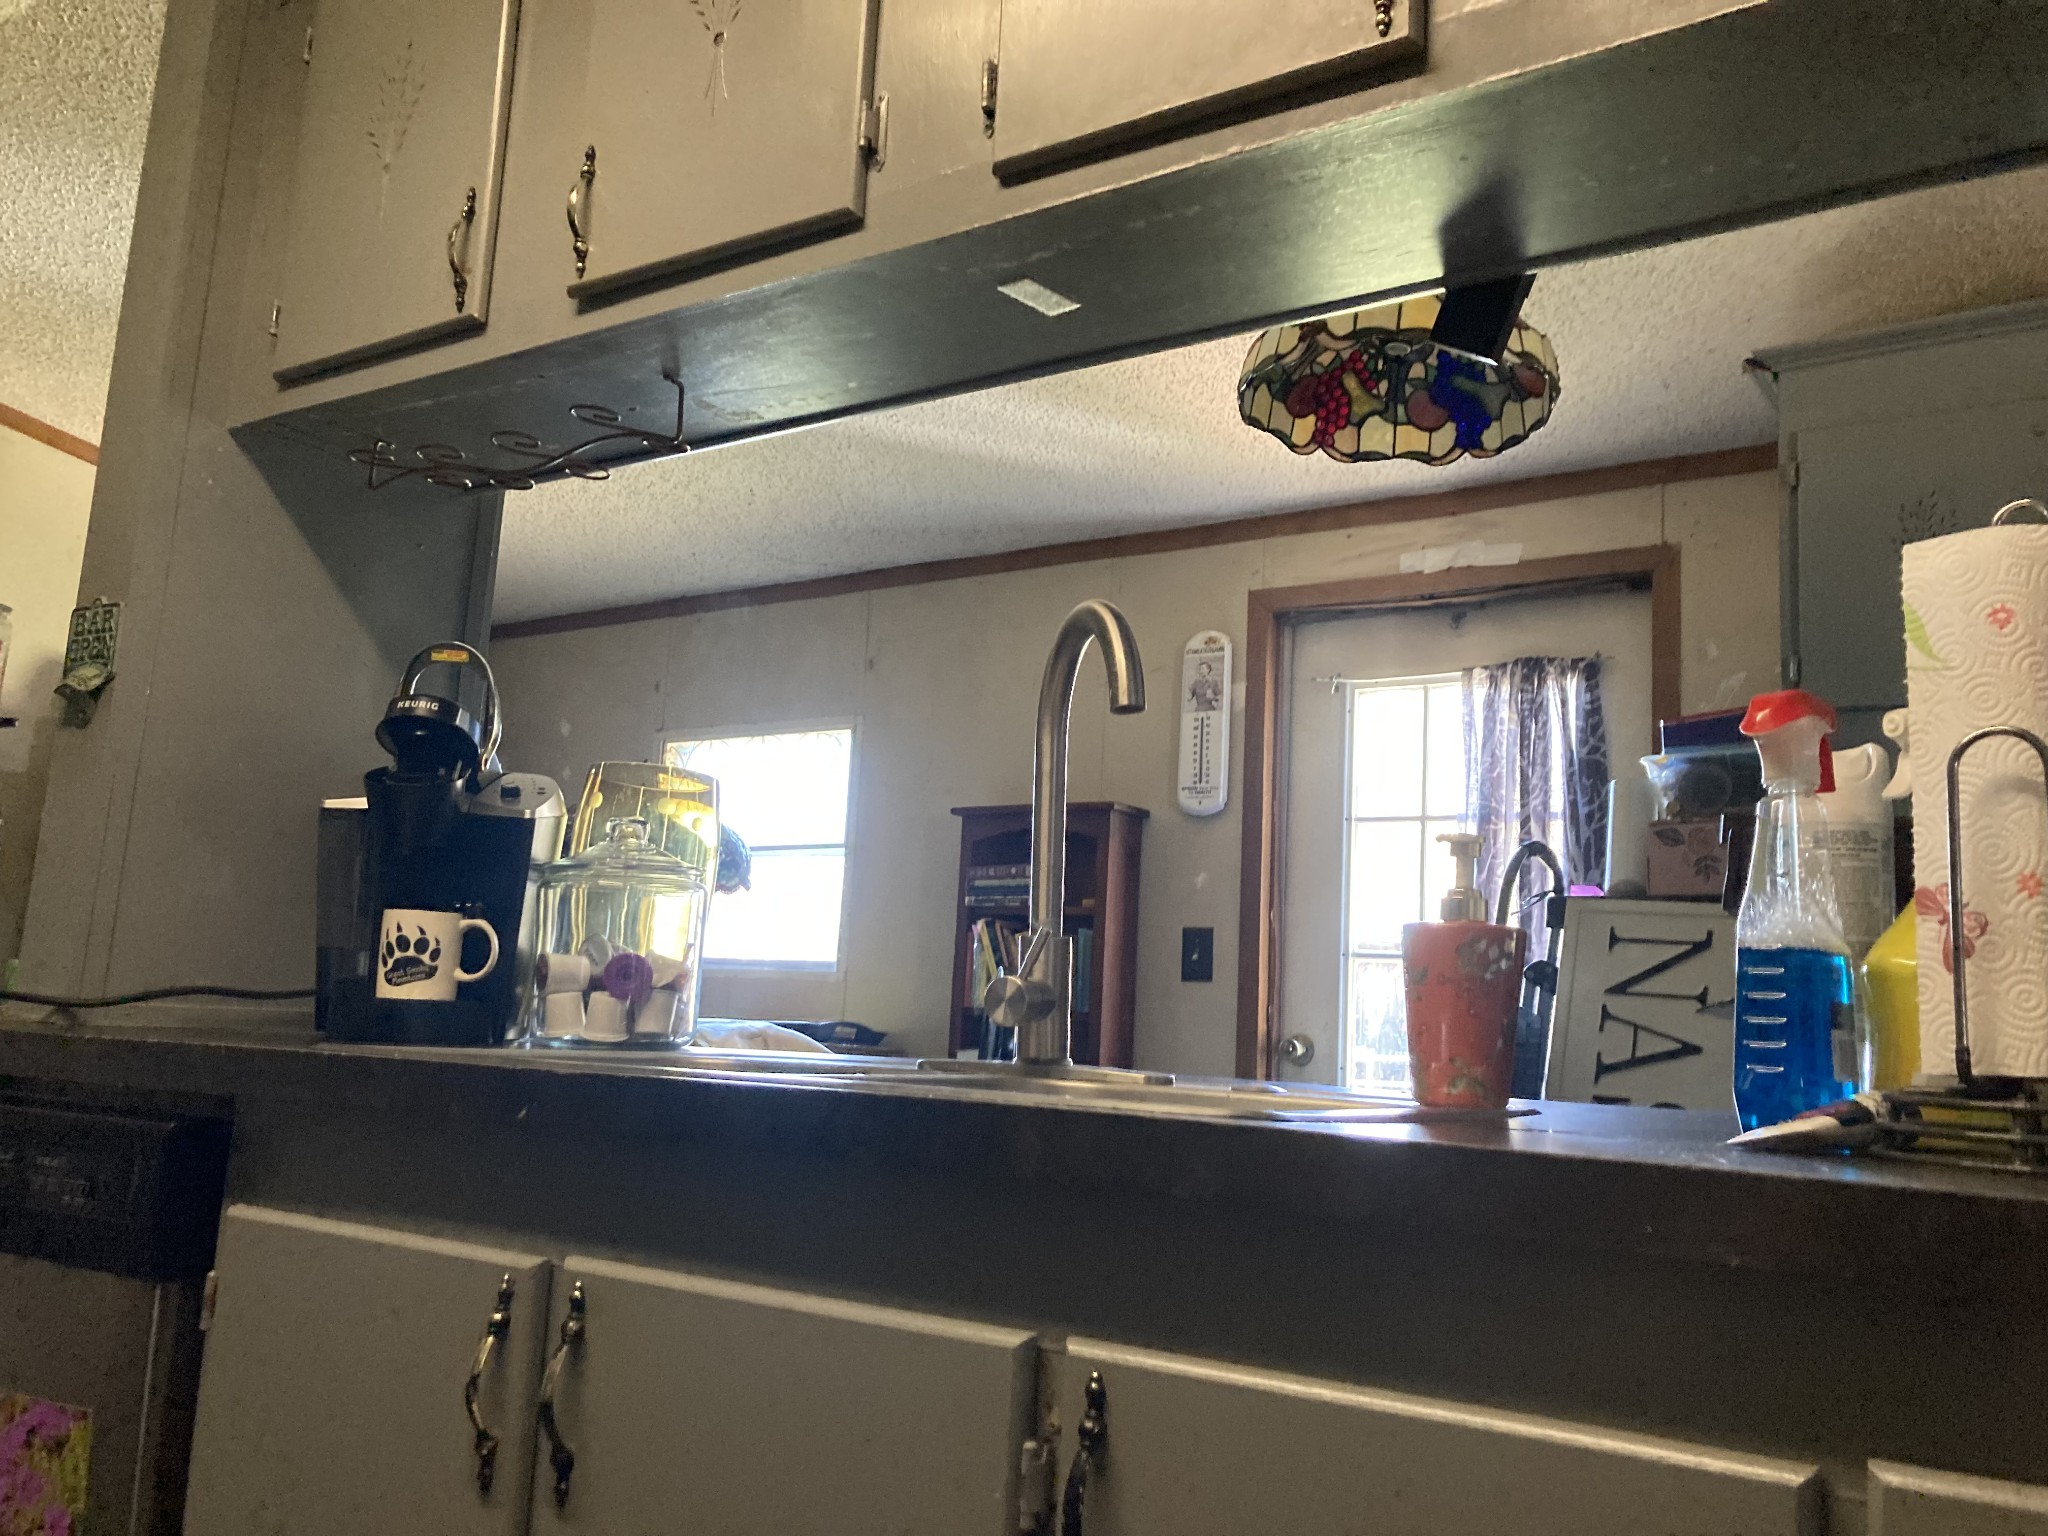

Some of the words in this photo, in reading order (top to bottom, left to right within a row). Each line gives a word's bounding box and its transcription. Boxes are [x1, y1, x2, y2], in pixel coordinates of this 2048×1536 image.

[73, 609, 114, 637] BAR
[69, 633, 113, 662] OPEN
[397, 700, 440, 711] KEURIG
[1592, 925, 1714, 1110] NA
